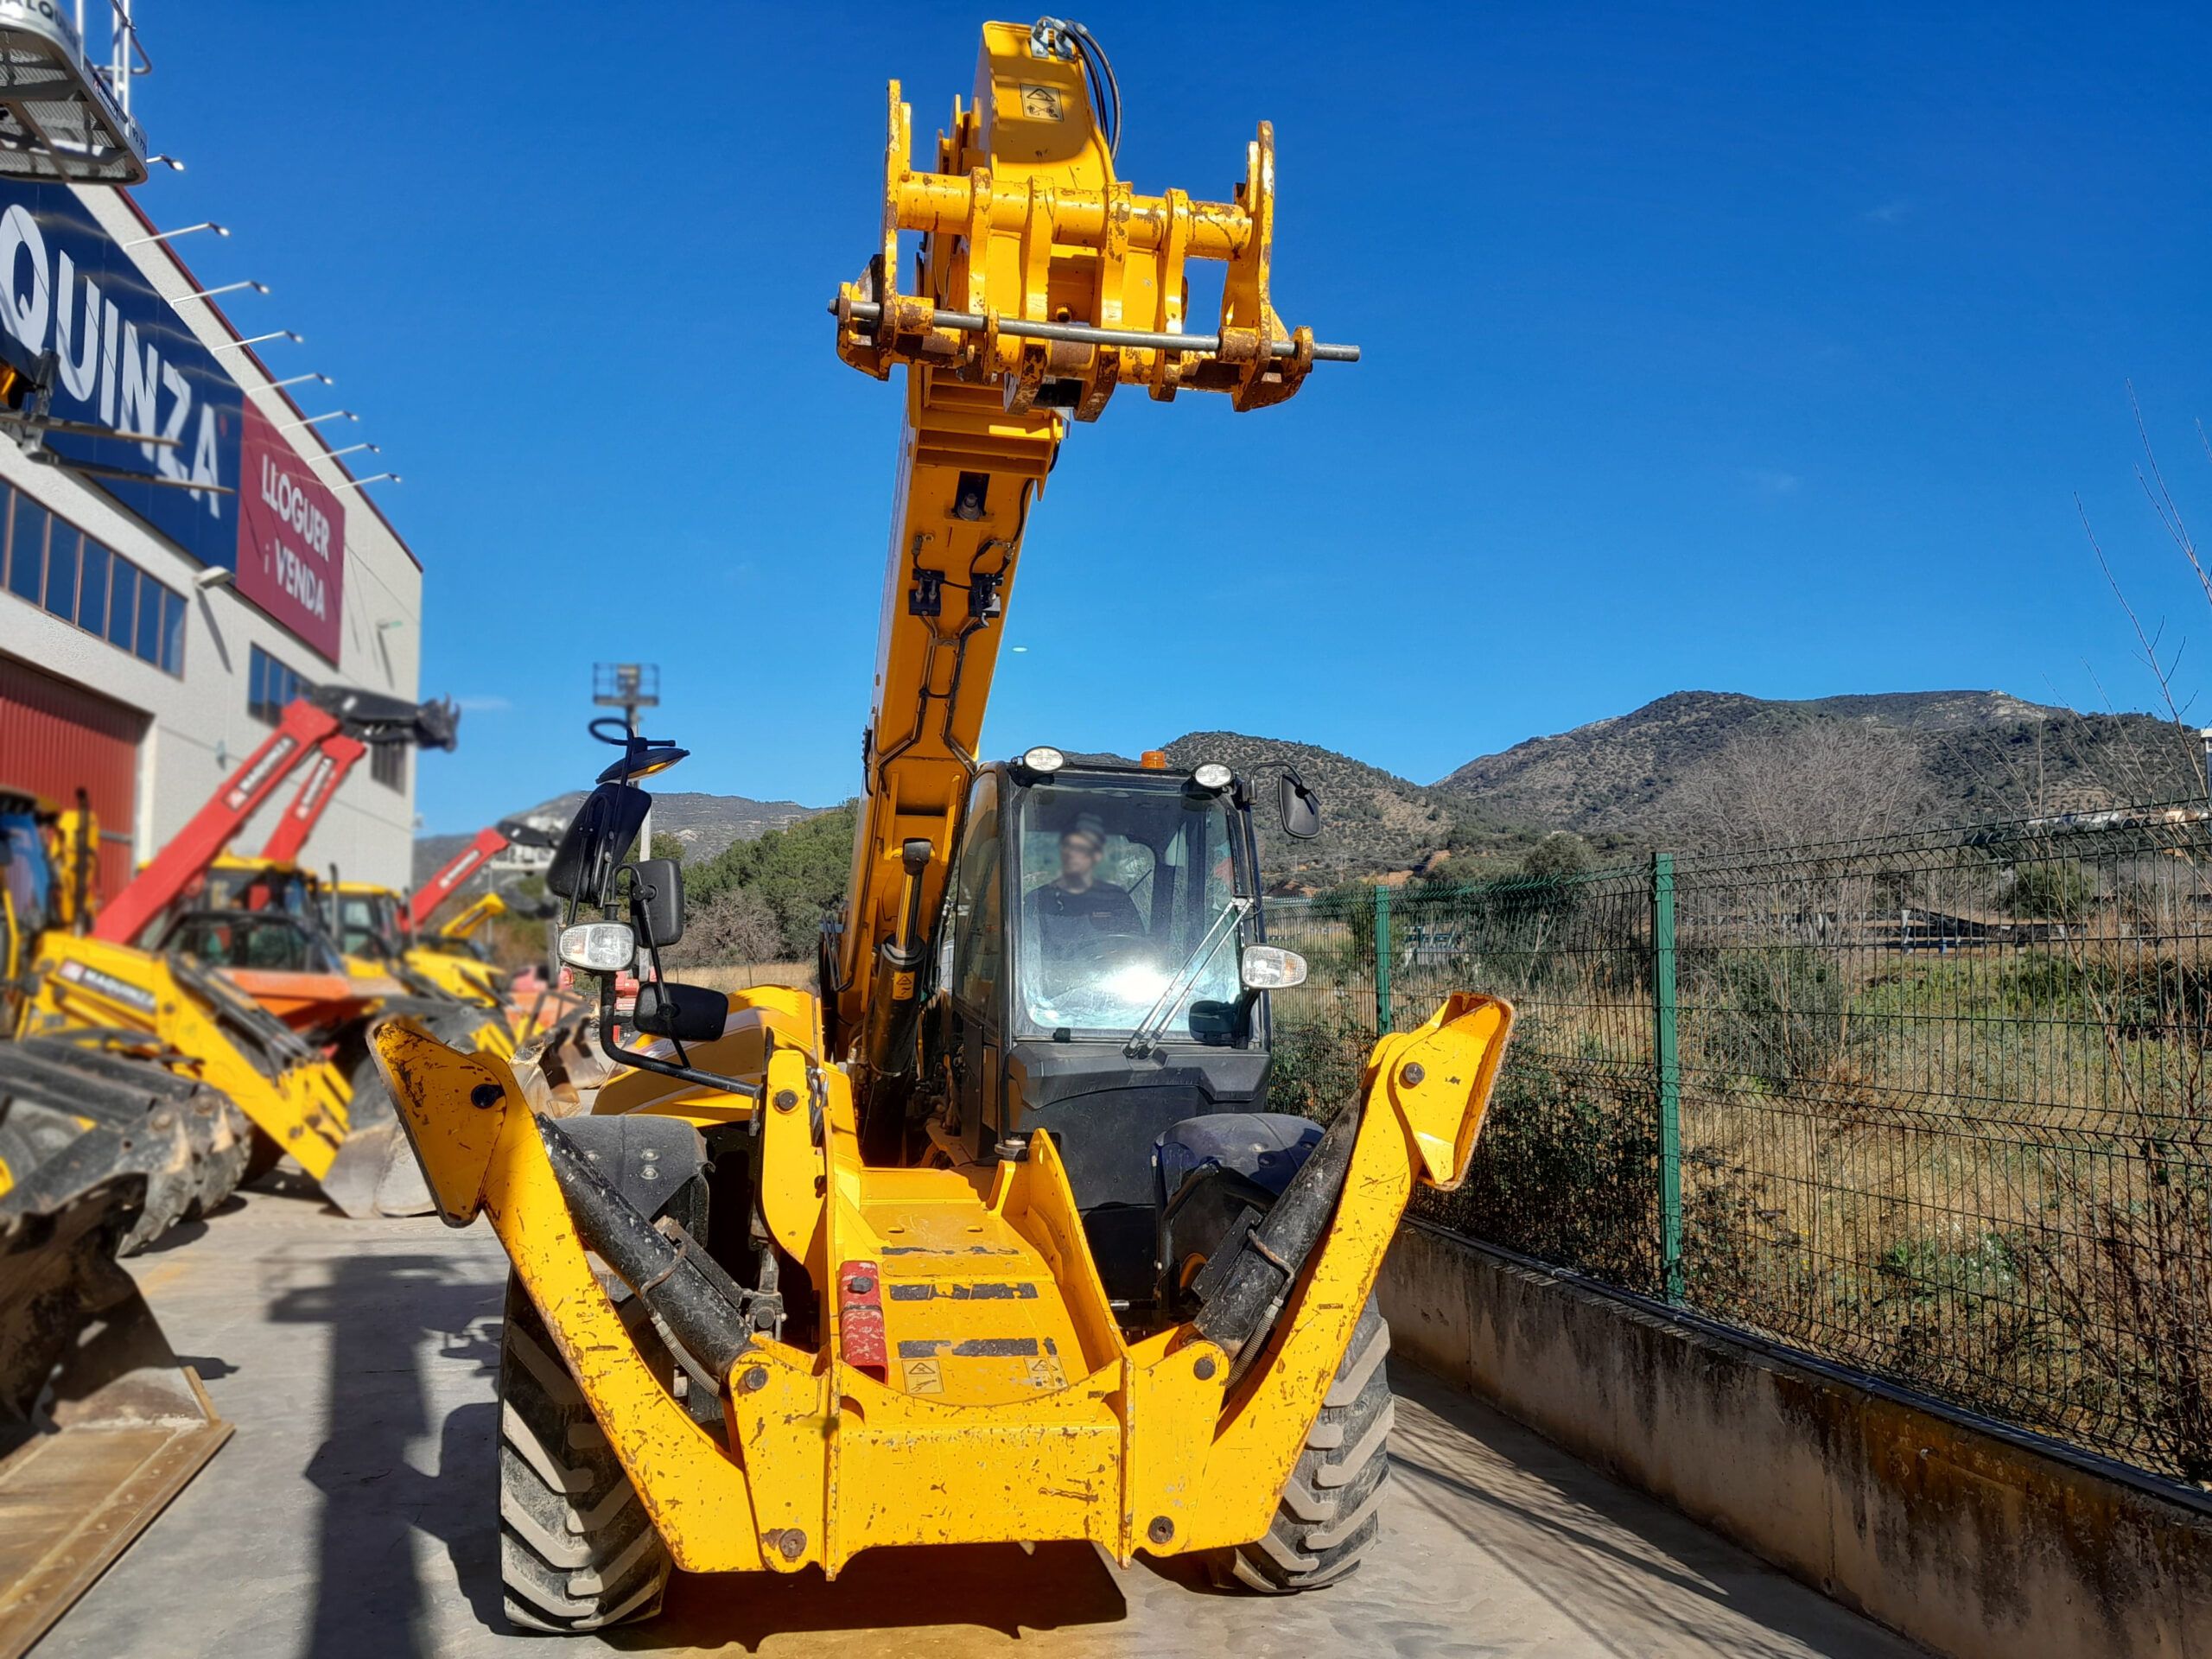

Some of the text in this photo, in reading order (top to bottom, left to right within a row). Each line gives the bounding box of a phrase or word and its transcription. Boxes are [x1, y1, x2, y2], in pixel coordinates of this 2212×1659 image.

[262, 454, 330, 562] LLOGUER
[264, 537, 326, 621] i VENDA
